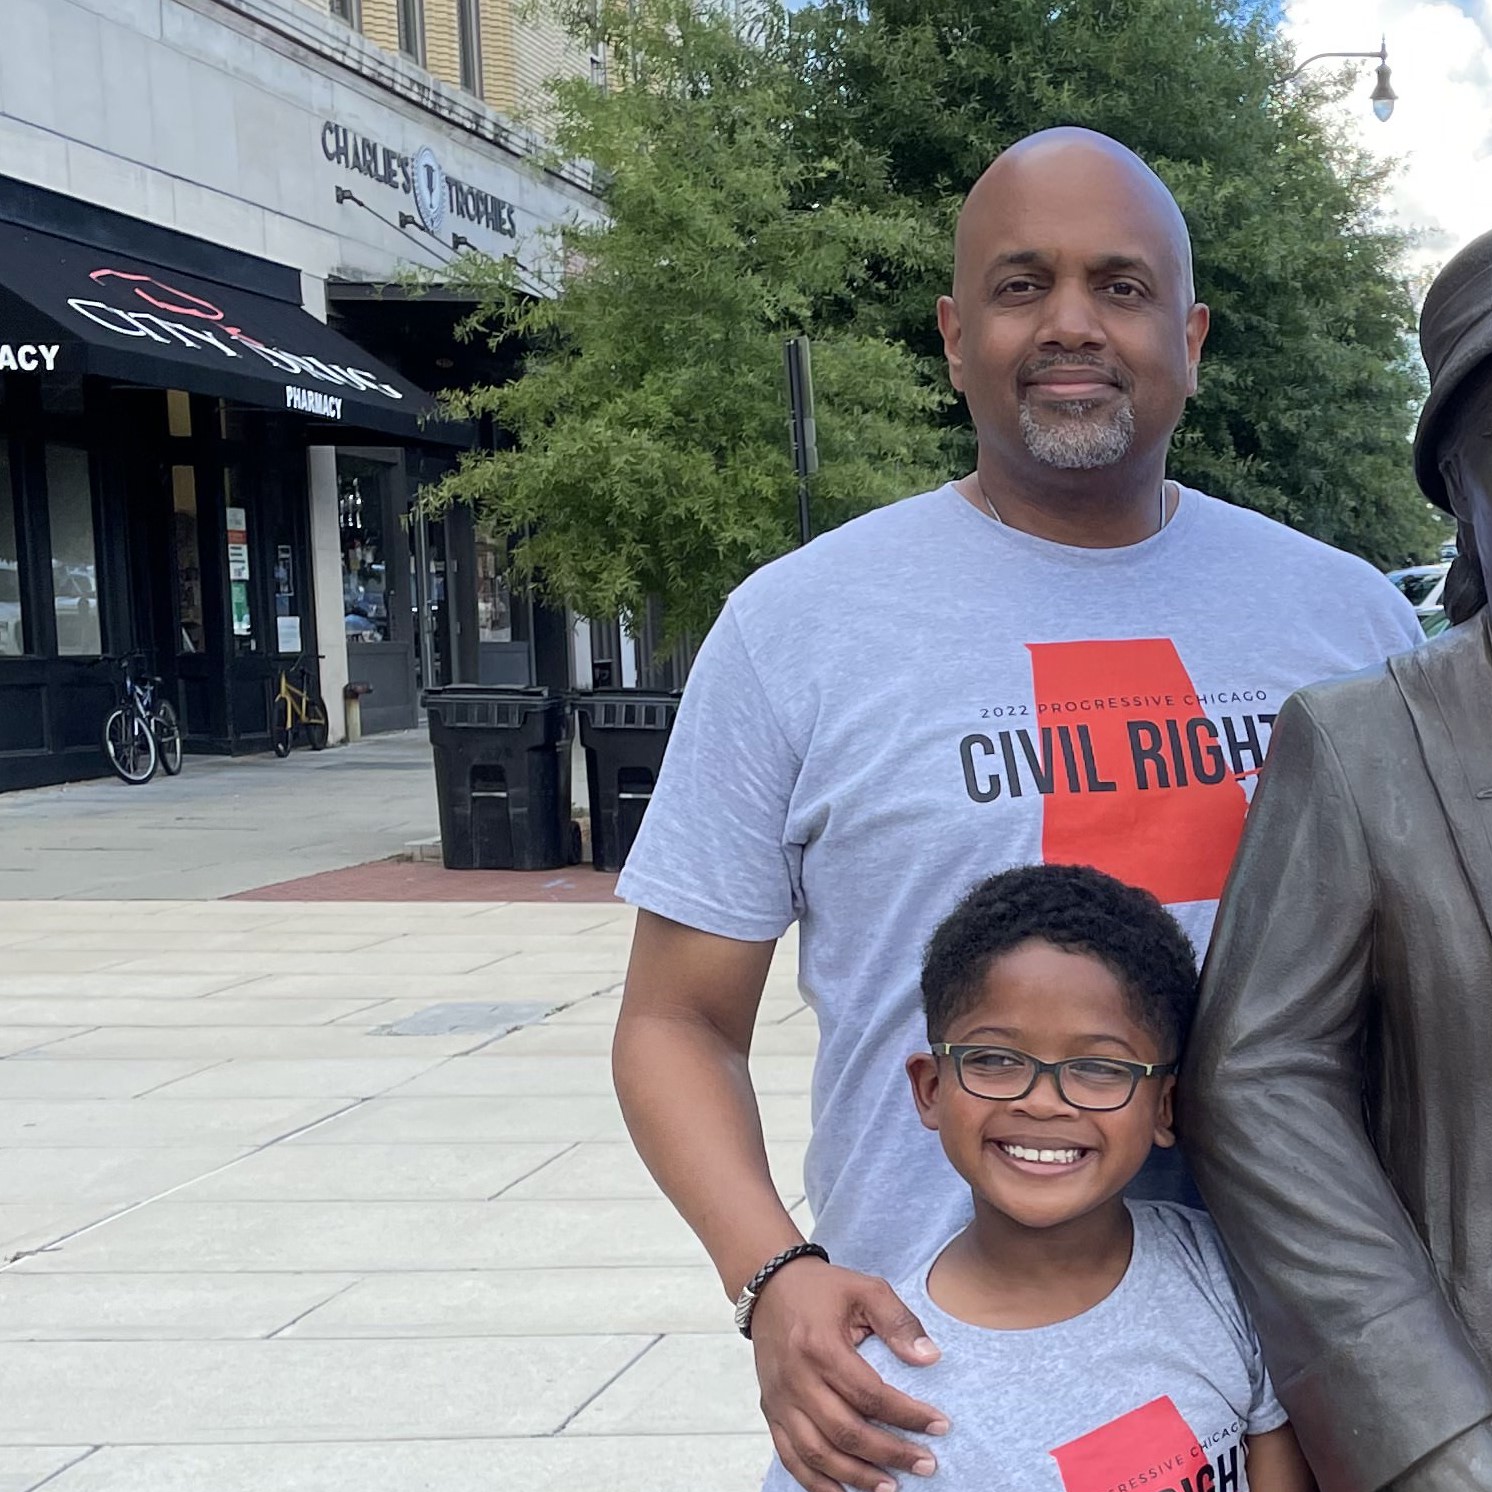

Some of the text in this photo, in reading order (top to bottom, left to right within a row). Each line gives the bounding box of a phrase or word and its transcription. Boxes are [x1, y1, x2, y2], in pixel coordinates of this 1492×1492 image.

[321, 120, 517, 239] CHARLIE'S TROPHIES
[285, 385, 343, 420] PHARMACY
[980, 689, 1267, 719] 2022 PROGRESSIVE CHICAGO
[959, 723, 1117, 804] CIVIL
